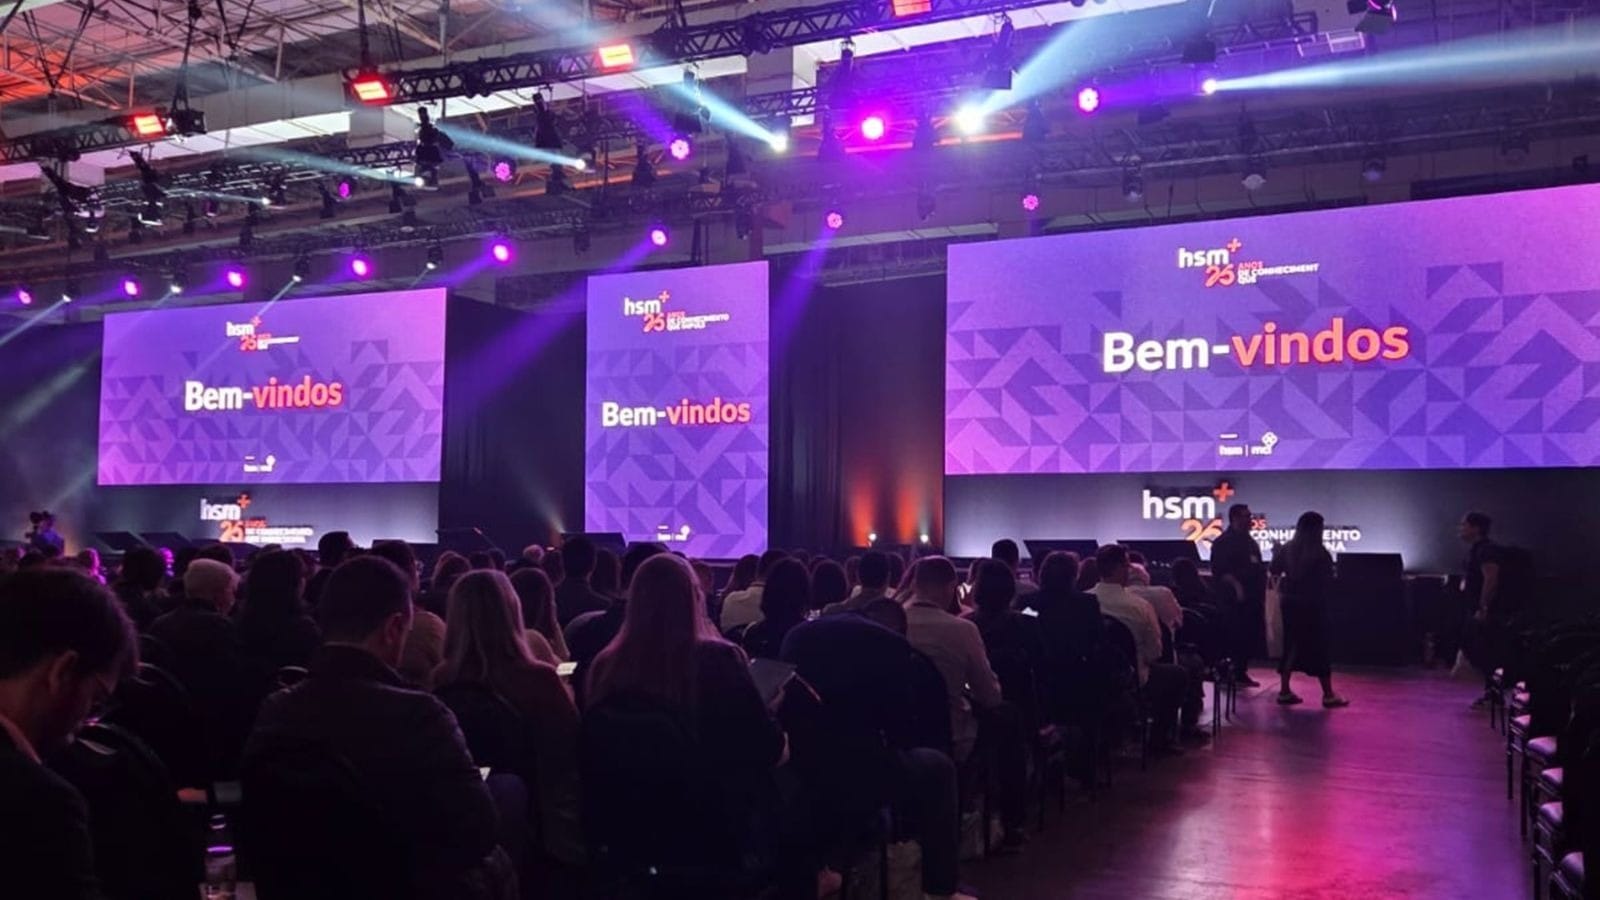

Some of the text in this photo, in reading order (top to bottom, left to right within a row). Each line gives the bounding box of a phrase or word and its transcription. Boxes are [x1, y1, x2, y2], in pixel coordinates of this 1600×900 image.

[1102, 317, 1409, 373] Bem-vindos
[184, 375, 343, 411] Bem-vindos
[602, 397, 751, 427] Bem-vindos
